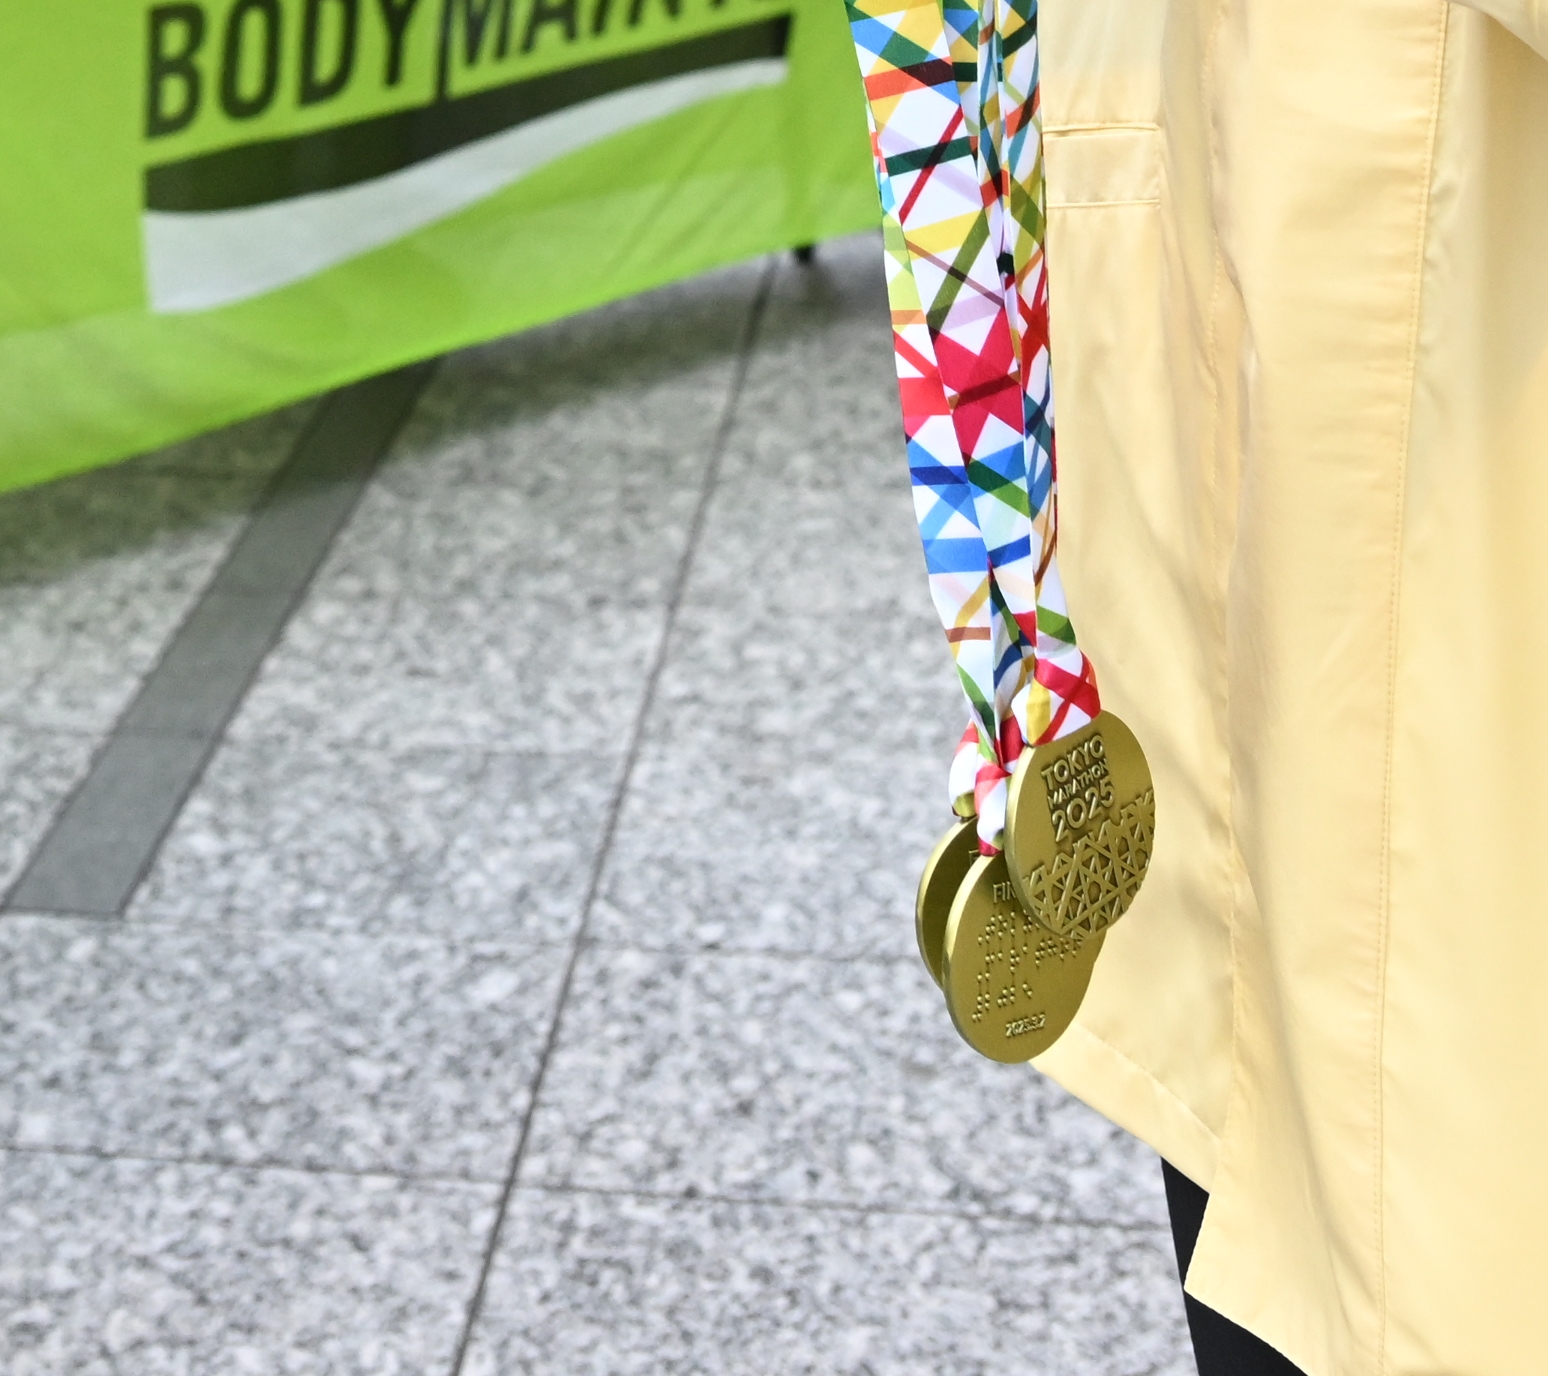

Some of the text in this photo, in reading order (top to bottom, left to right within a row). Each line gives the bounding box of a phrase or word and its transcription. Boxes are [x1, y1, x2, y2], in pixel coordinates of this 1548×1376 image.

[1041, 734, 1104, 791] TOKYO
[1047, 758, 1109, 810] MARATHON
[1052, 775, 1115, 843] 2025
